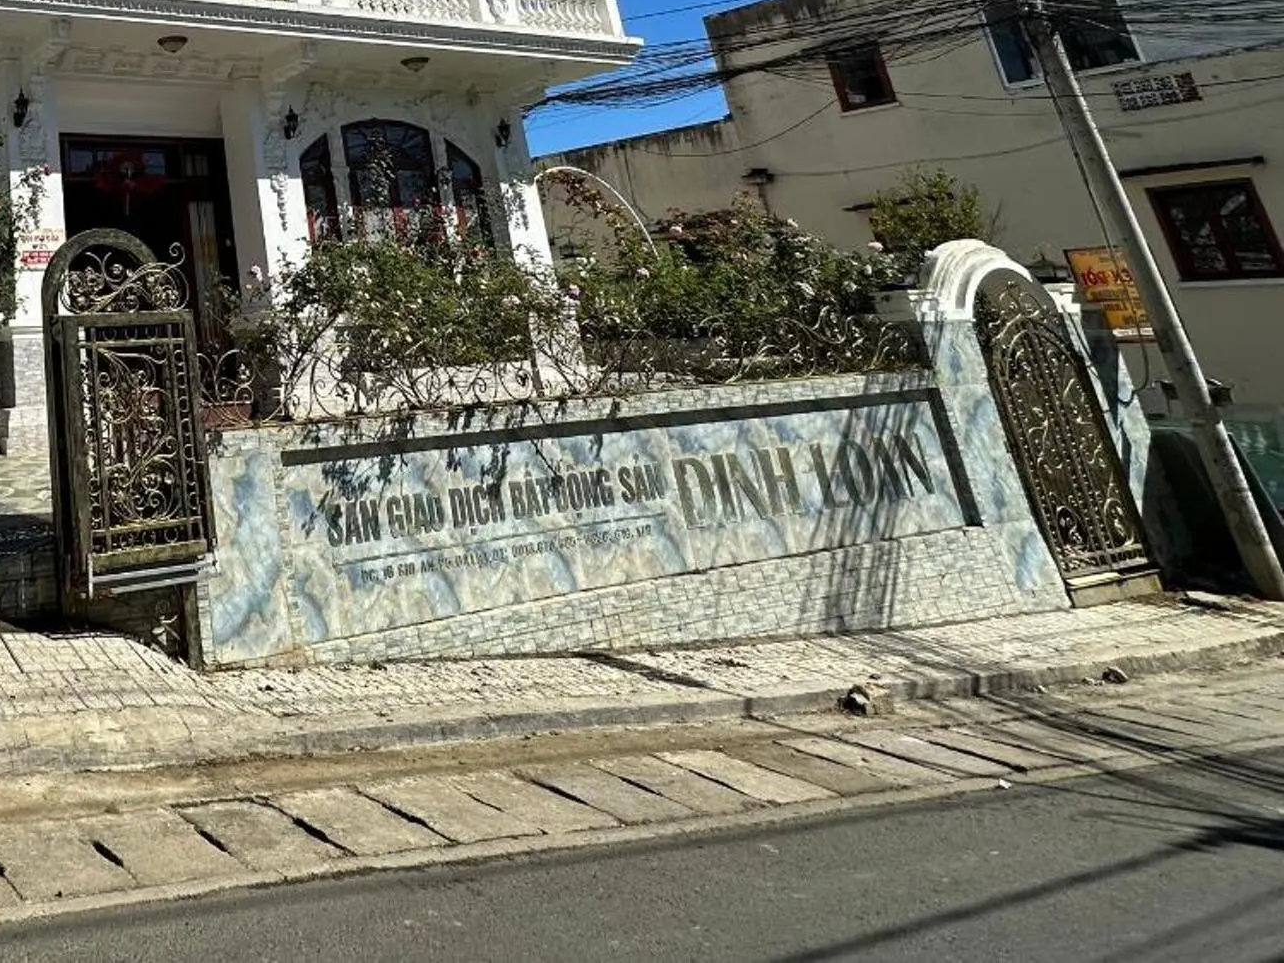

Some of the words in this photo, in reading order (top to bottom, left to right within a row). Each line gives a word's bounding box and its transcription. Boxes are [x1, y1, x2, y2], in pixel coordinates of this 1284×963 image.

[386, 492, 446, 539] GIAO
[448, 481, 506, 536] DỊCH
[671, 444, 806, 530] DINH
[808, 431, 936, 510] LOAN
